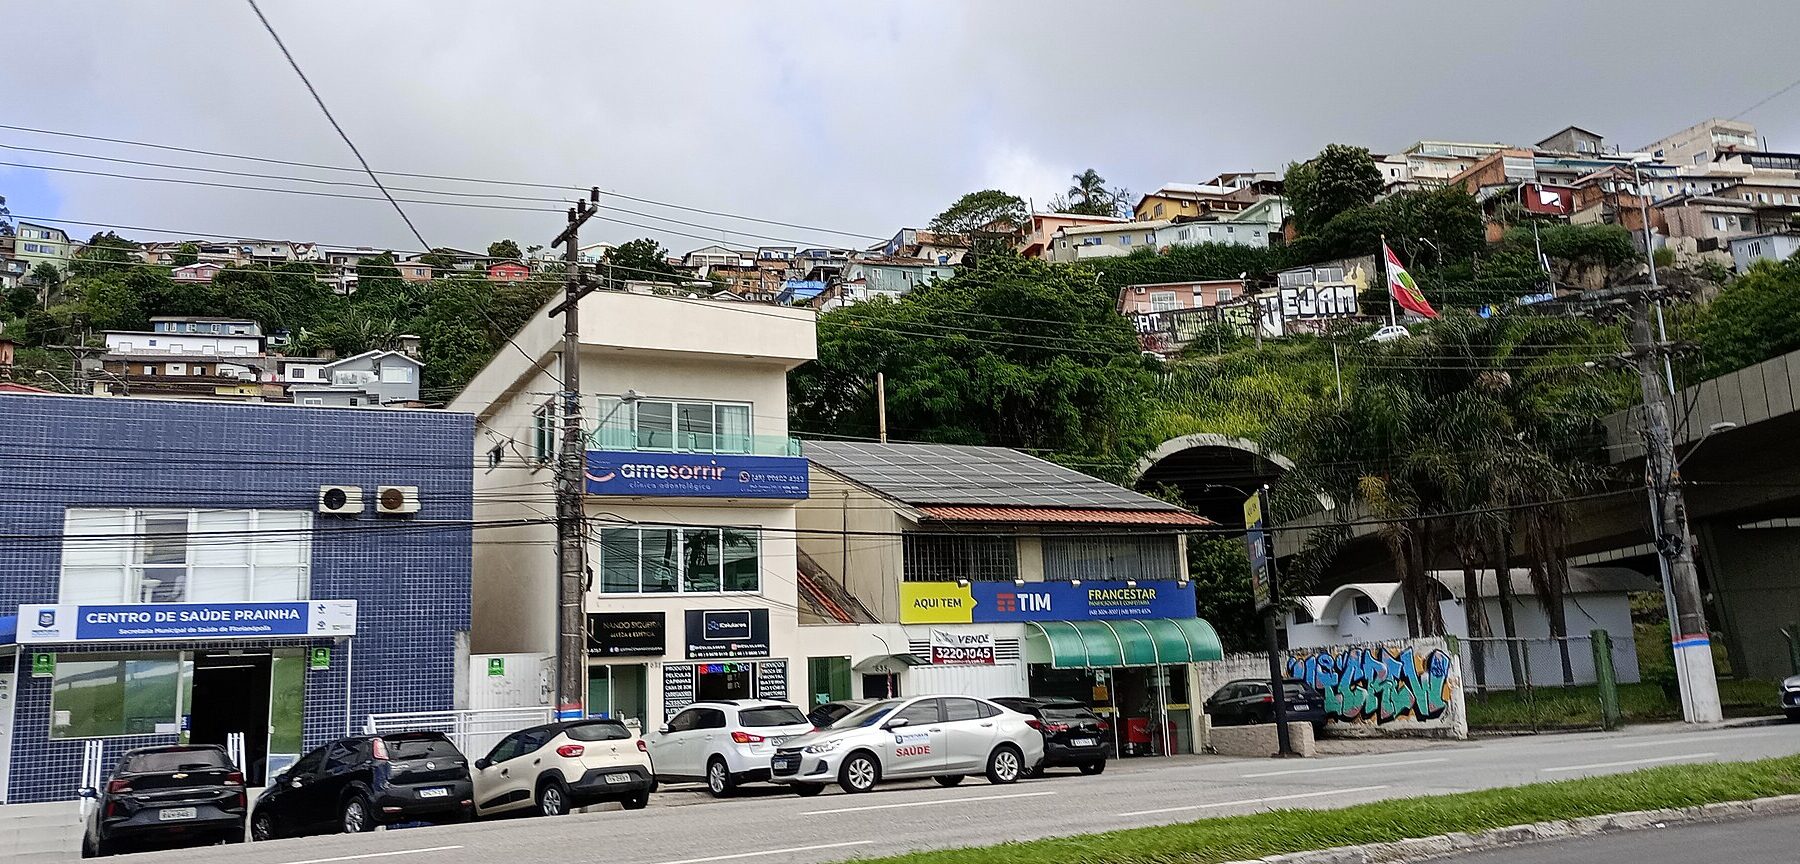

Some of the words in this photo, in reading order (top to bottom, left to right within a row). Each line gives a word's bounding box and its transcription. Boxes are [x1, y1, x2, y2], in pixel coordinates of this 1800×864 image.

[621, 459, 726, 481] amesorrir
[1088, 589, 1156, 600] FRANCESTAR
[914, 598, 939, 610] AQUI
[941, 598, 962, 608] TEM
[1017, 593, 1052, 612] TIM
[86, 612, 152, 624] CENTRO
[155, 612, 177, 622] DE
[180, 608, 231, 622] SAÚDE
[234, 609, 300, 620] PRAINHA
[154, 627, 187, 635] Municipal
[229, 625, 272, 633] Florianópolis
[896, 746, 930, 757] SAÚDE
